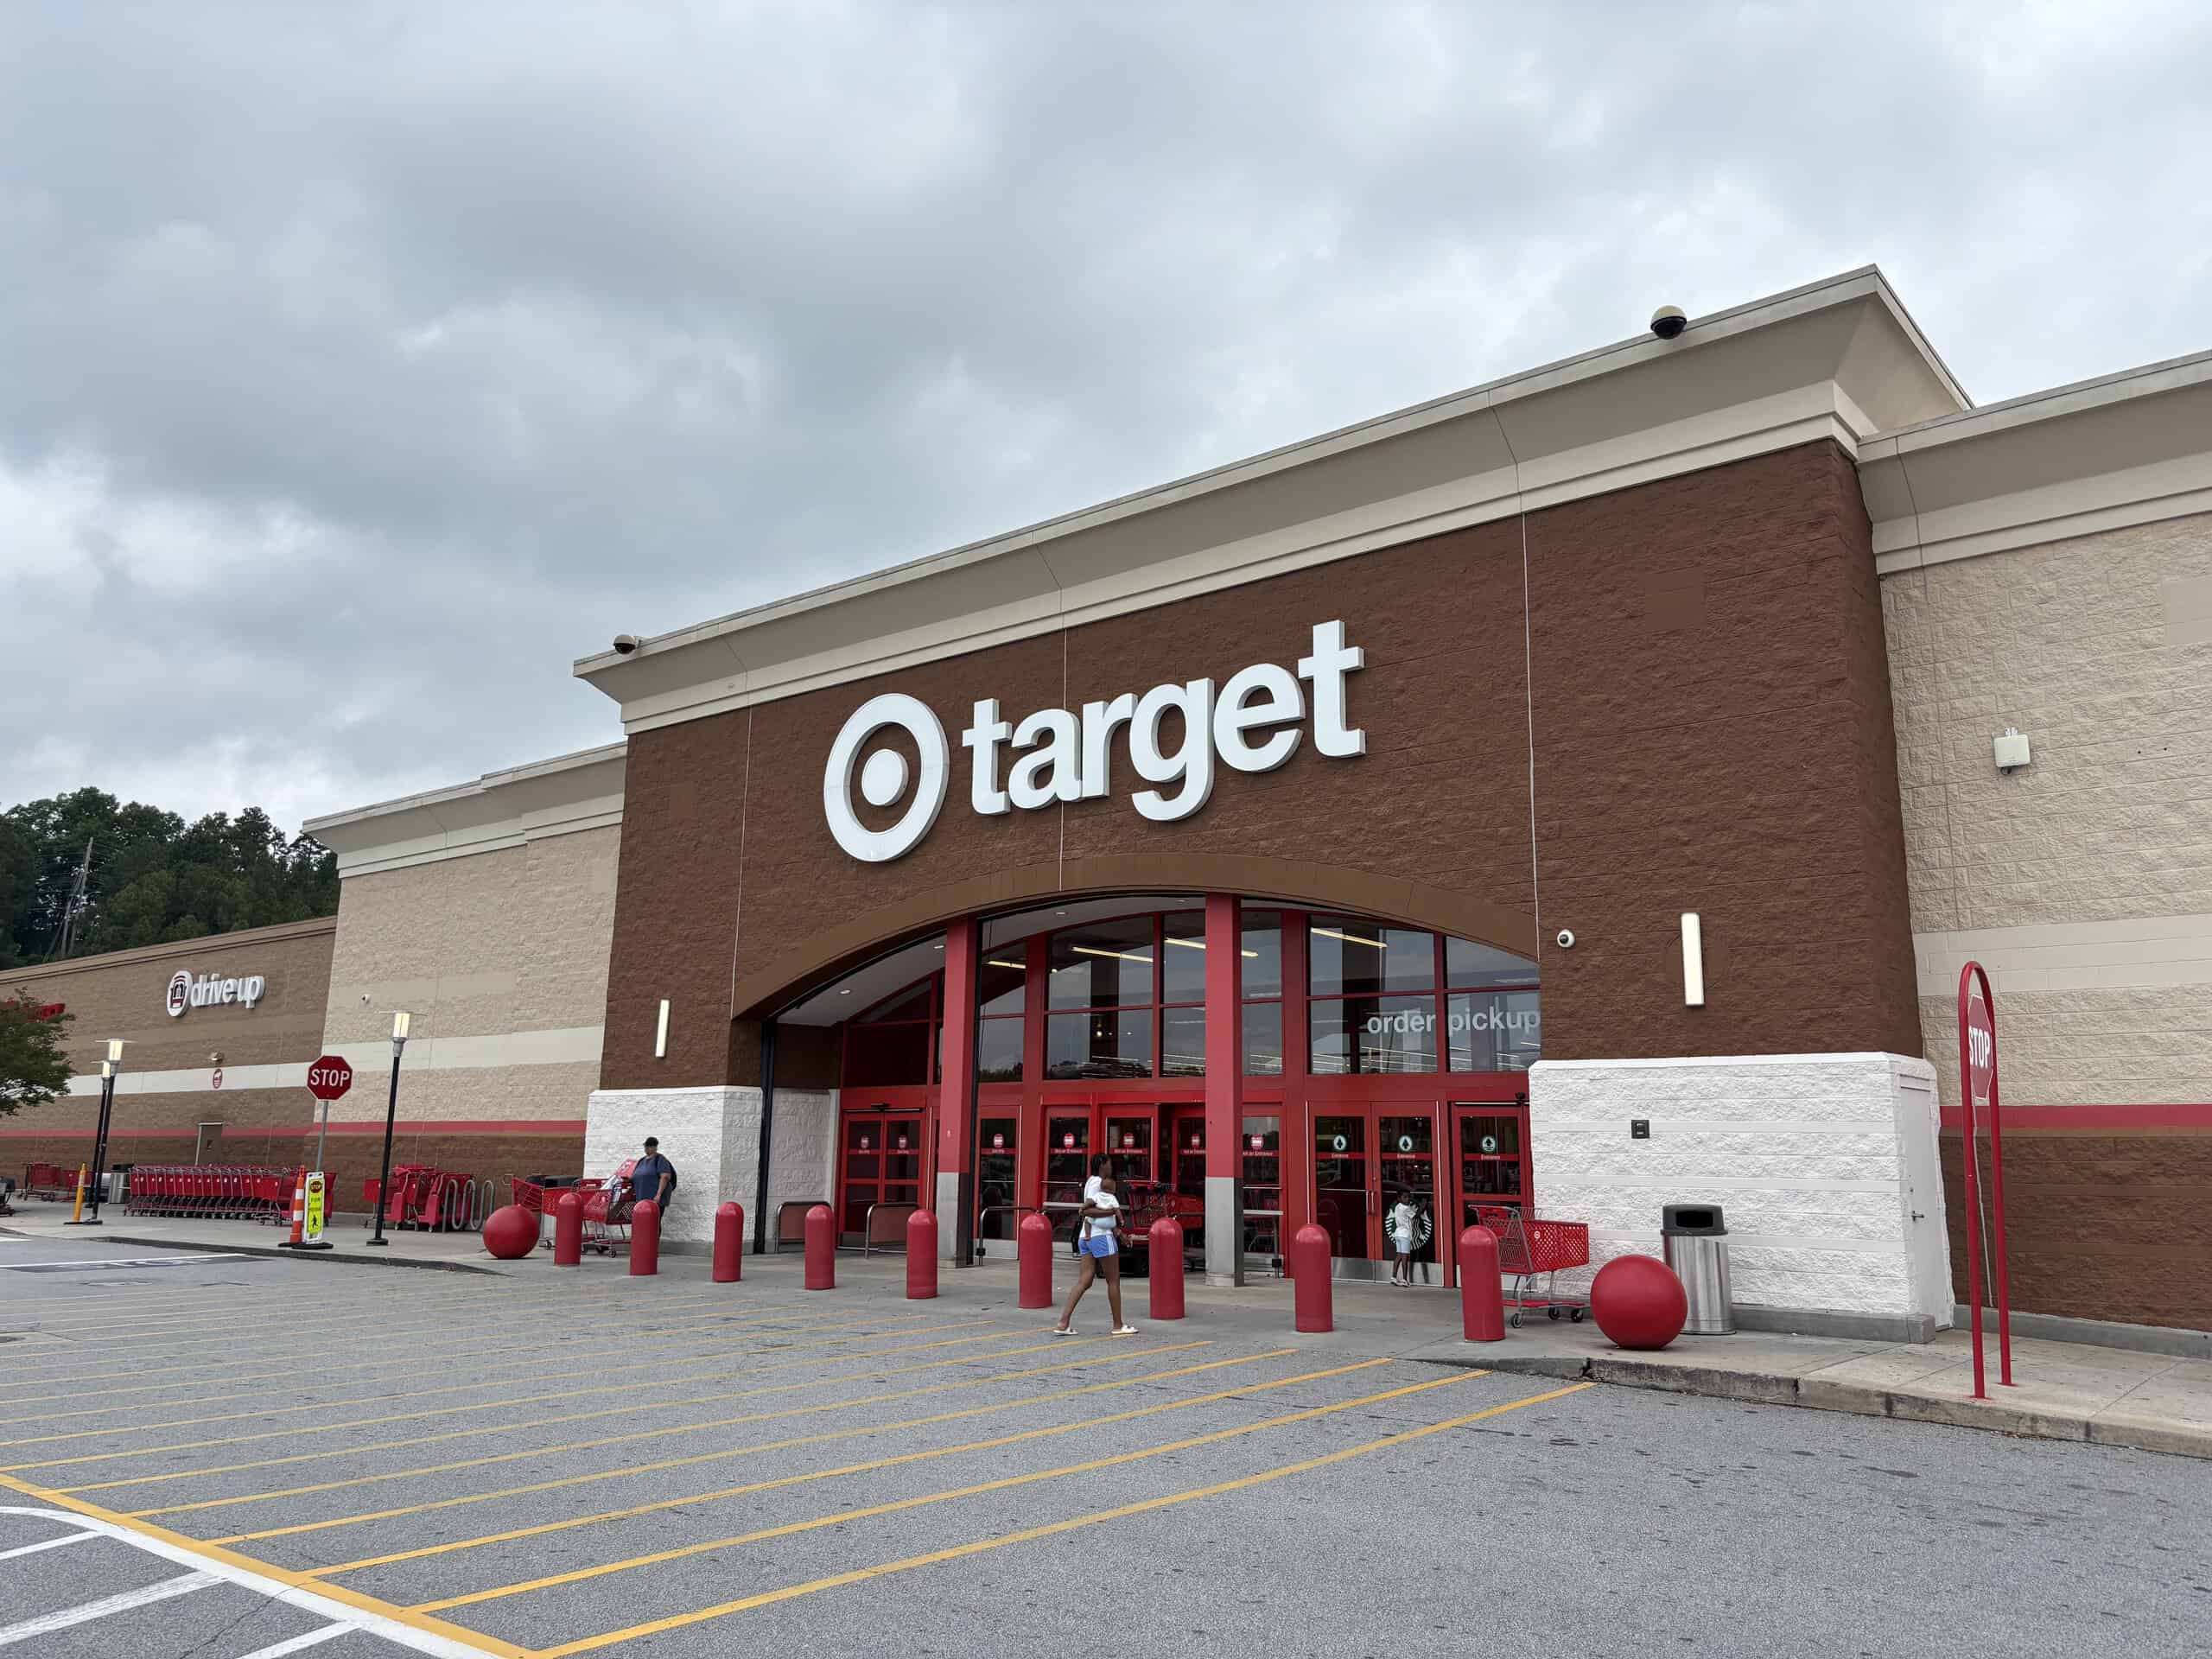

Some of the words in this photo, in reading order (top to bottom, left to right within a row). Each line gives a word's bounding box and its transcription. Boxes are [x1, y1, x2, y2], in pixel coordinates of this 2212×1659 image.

[962, 620, 1365, 822] target
[191, 973, 238, 1007] drive
[238, 976, 265, 1009] up
[1367, 1008, 1436, 1033] order
[1448, 1005, 1541, 1037] pickup
[1968, 1025, 1991, 1069] STOP
[310, 1068, 350, 1087] STOP
